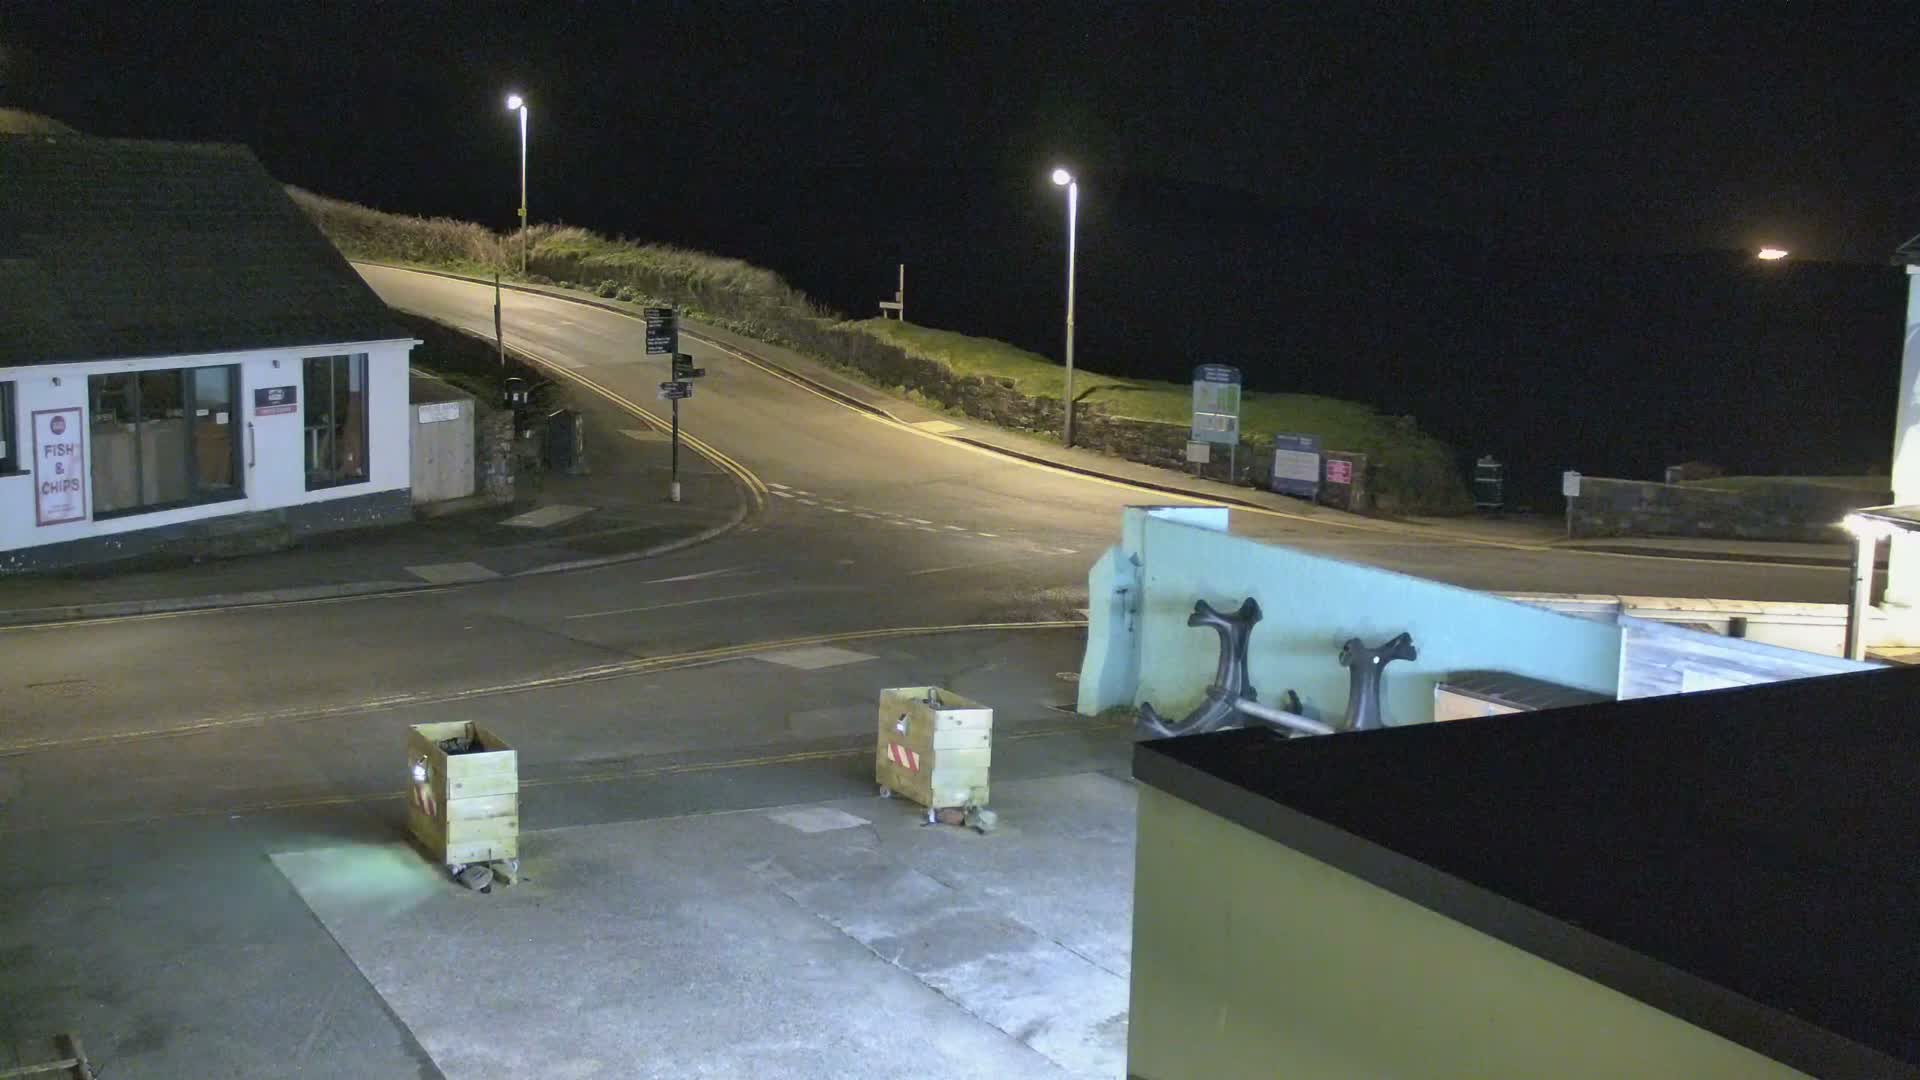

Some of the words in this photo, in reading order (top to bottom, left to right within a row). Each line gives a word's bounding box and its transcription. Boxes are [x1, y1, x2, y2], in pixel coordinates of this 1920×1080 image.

[44, 443, 74, 458] FISH
[55, 462, 65, 475] &
[41, 478, 80, 495] CHIPS
